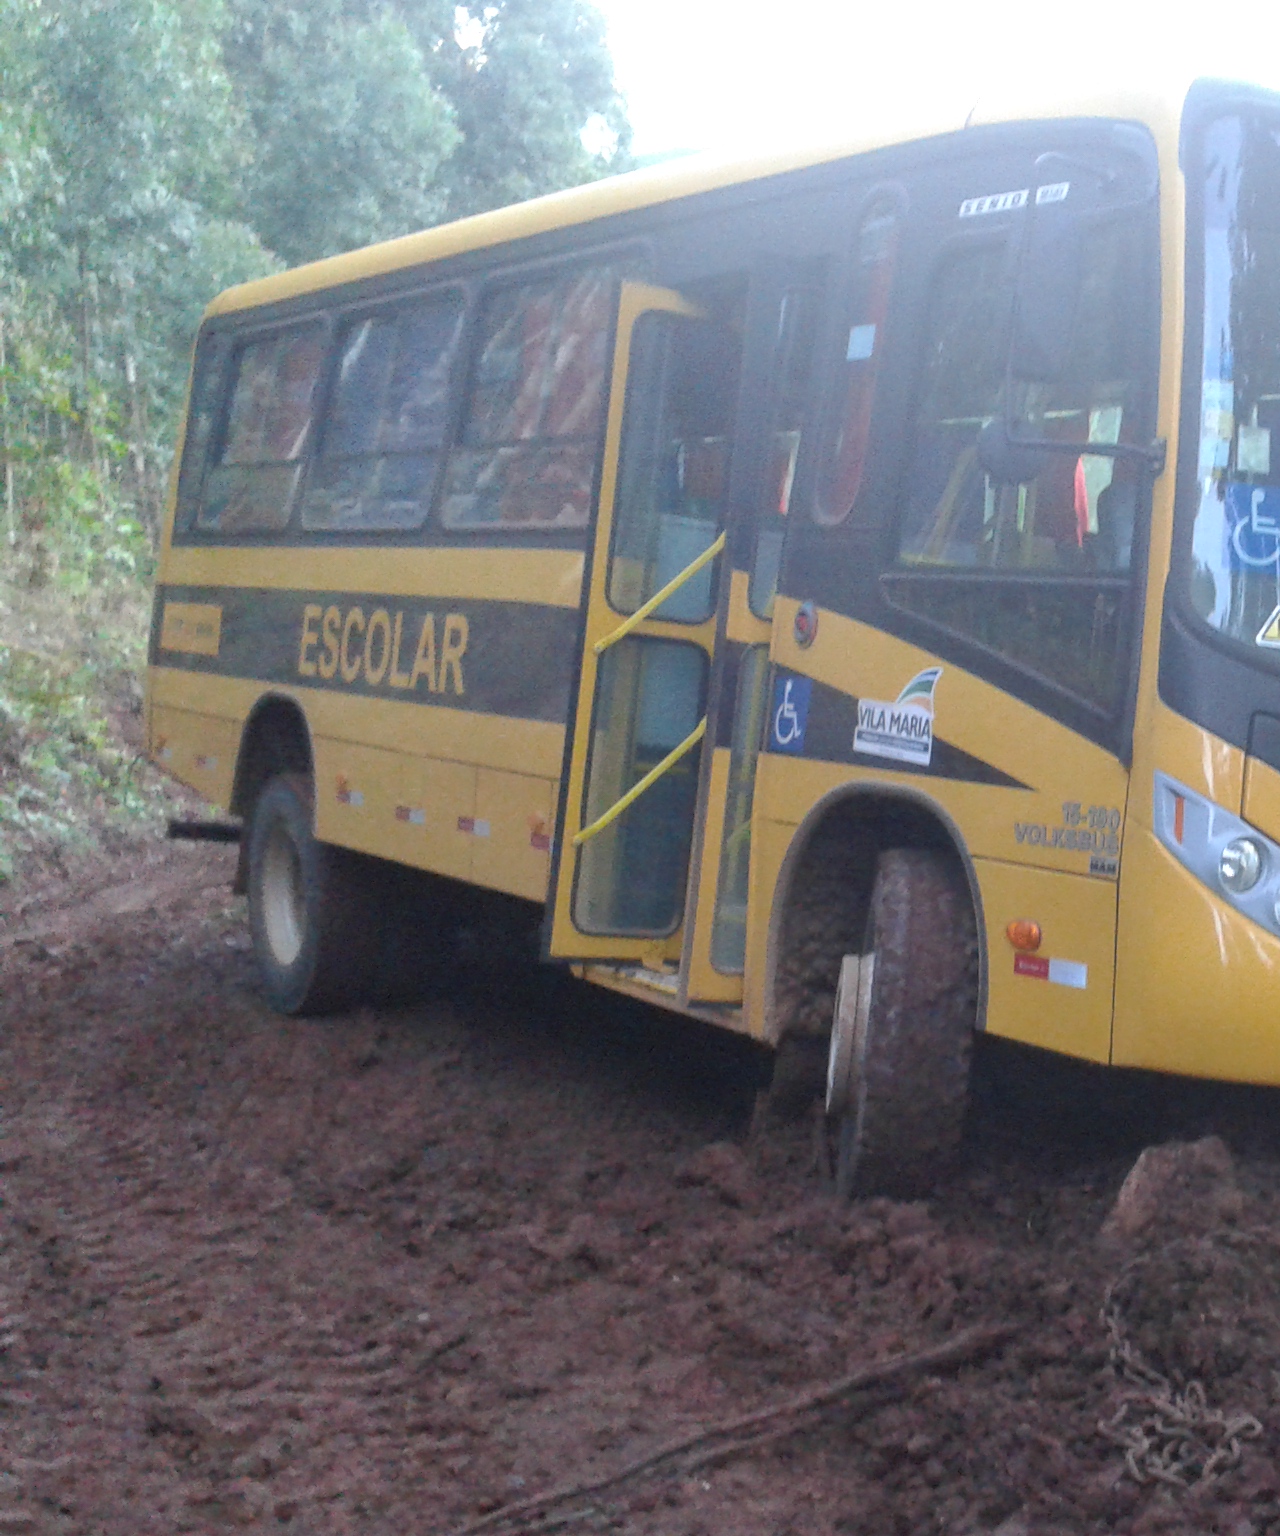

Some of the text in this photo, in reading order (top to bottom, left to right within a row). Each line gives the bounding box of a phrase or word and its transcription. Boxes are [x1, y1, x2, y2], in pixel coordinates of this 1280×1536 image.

[299, 603, 469, 696] ESCOLAR
[860, 706, 931, 740] VILA MARIA
[1014, 822, 1119, 856] VOLKSBUS
[1090, 860, 1117, 876] MAN
